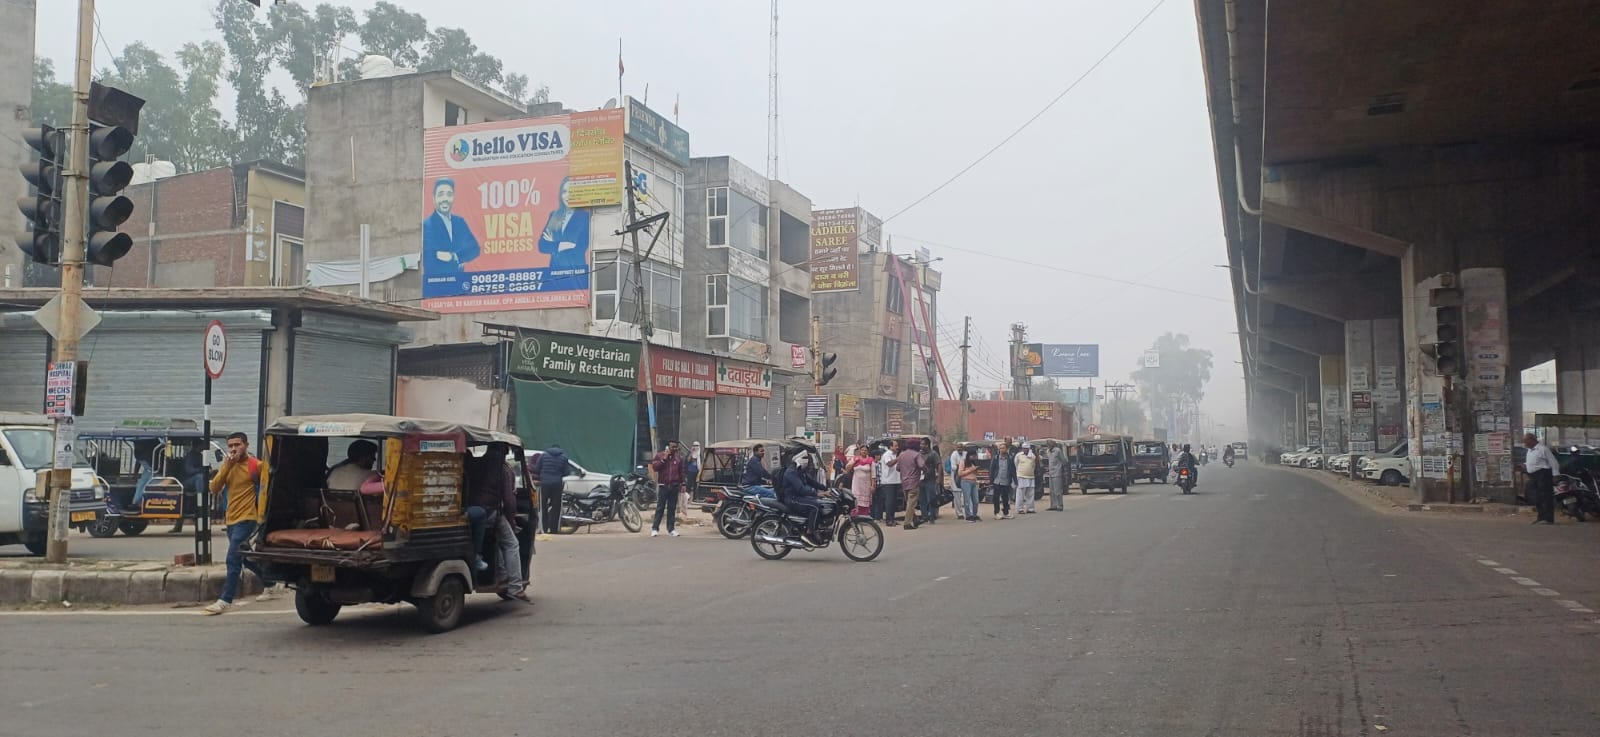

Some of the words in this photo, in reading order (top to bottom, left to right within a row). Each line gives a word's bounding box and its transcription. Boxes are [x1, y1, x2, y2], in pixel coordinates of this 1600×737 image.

[472, 136, 515, 156] hello
[517, 130, 564, 152] VISA
[477, 177, 541, 209] 100%
[483, 211, 534, 240] VISA
[484, 237, 534, 255] SUCCESS
[816, 236, 849, 247] SAREE
[471, 271, 543, 284] 90828-88887
[212, 334, 221, 346] GO
[208, 349, 223, 362] SLOW
[550, 341, 573, 356] Pure
[576, 344, 630, 363] Vegetarian
[542, 356, 576, 374] Family
[579, 361, 635, 379] Restaurant
